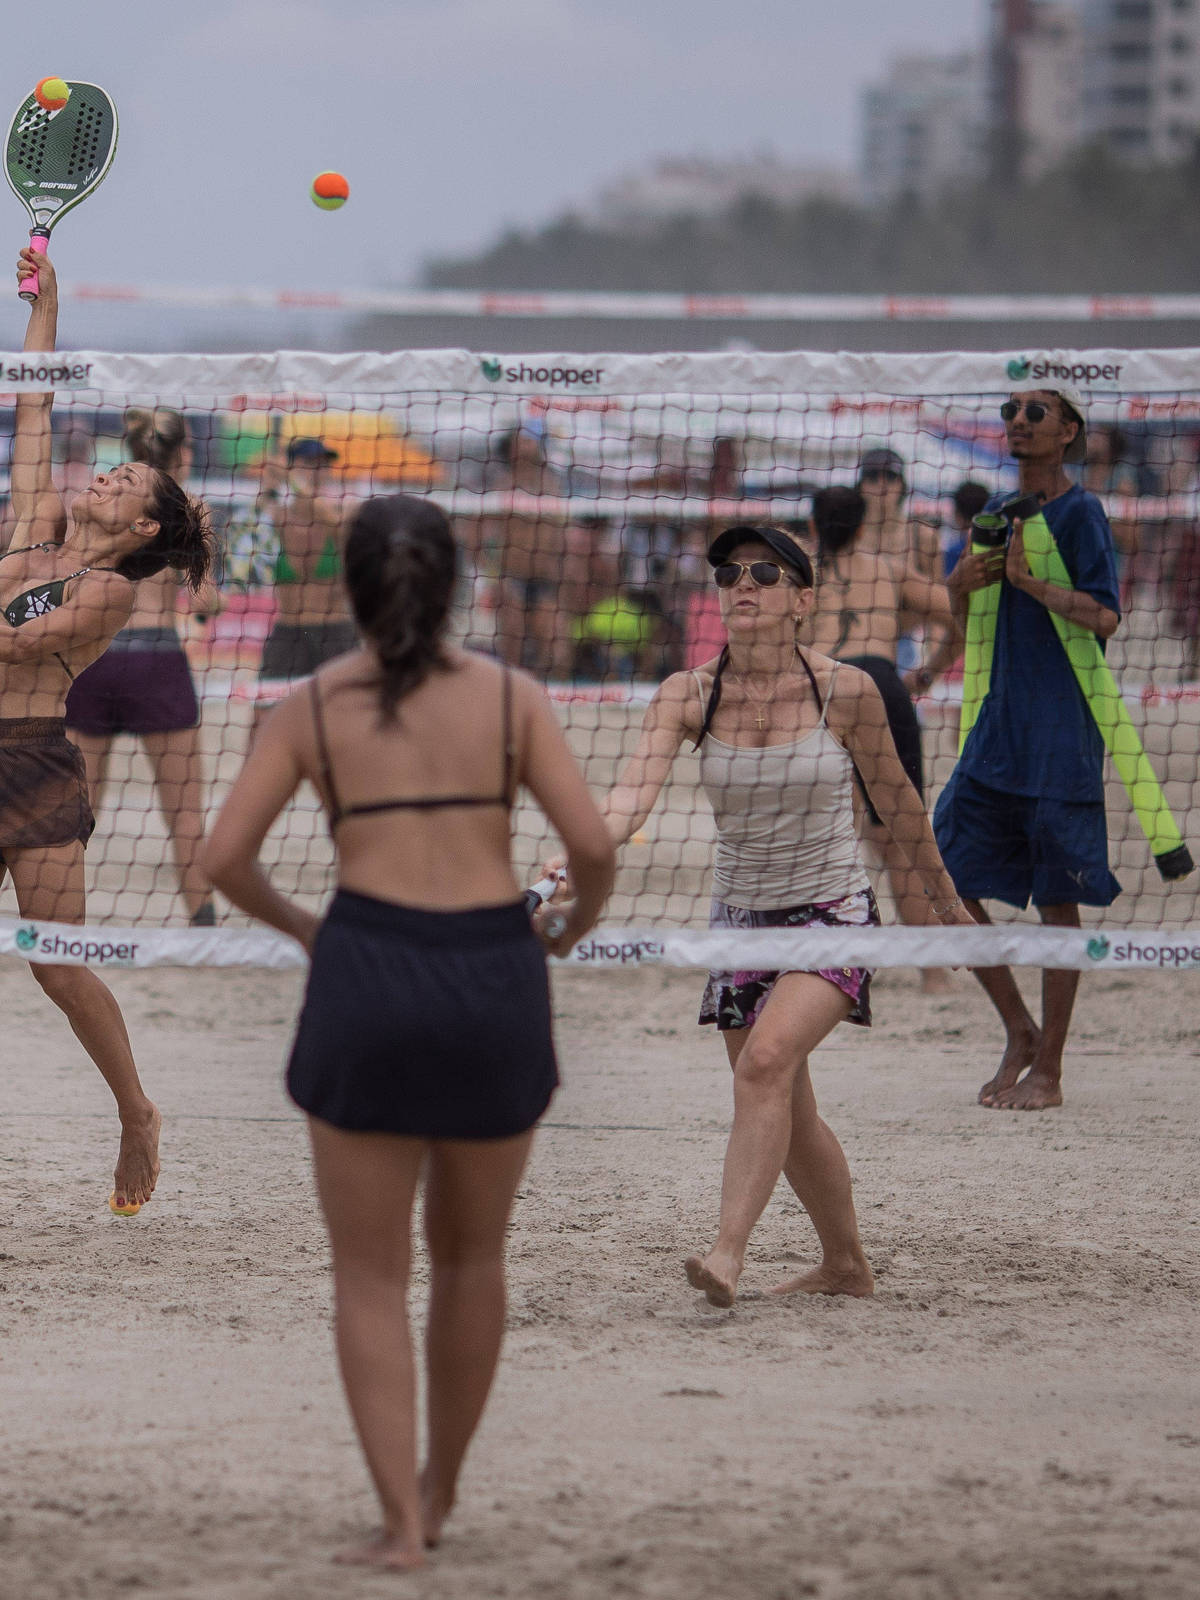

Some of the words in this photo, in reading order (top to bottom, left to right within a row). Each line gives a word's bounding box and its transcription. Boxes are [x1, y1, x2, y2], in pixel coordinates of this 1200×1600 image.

[505, 361, 605, 389] shopper
[1032, 360, 1123, 385] shopper
[40, 935, 139, 963] shopper
[1113, 941, 1200, 967] shoppe
